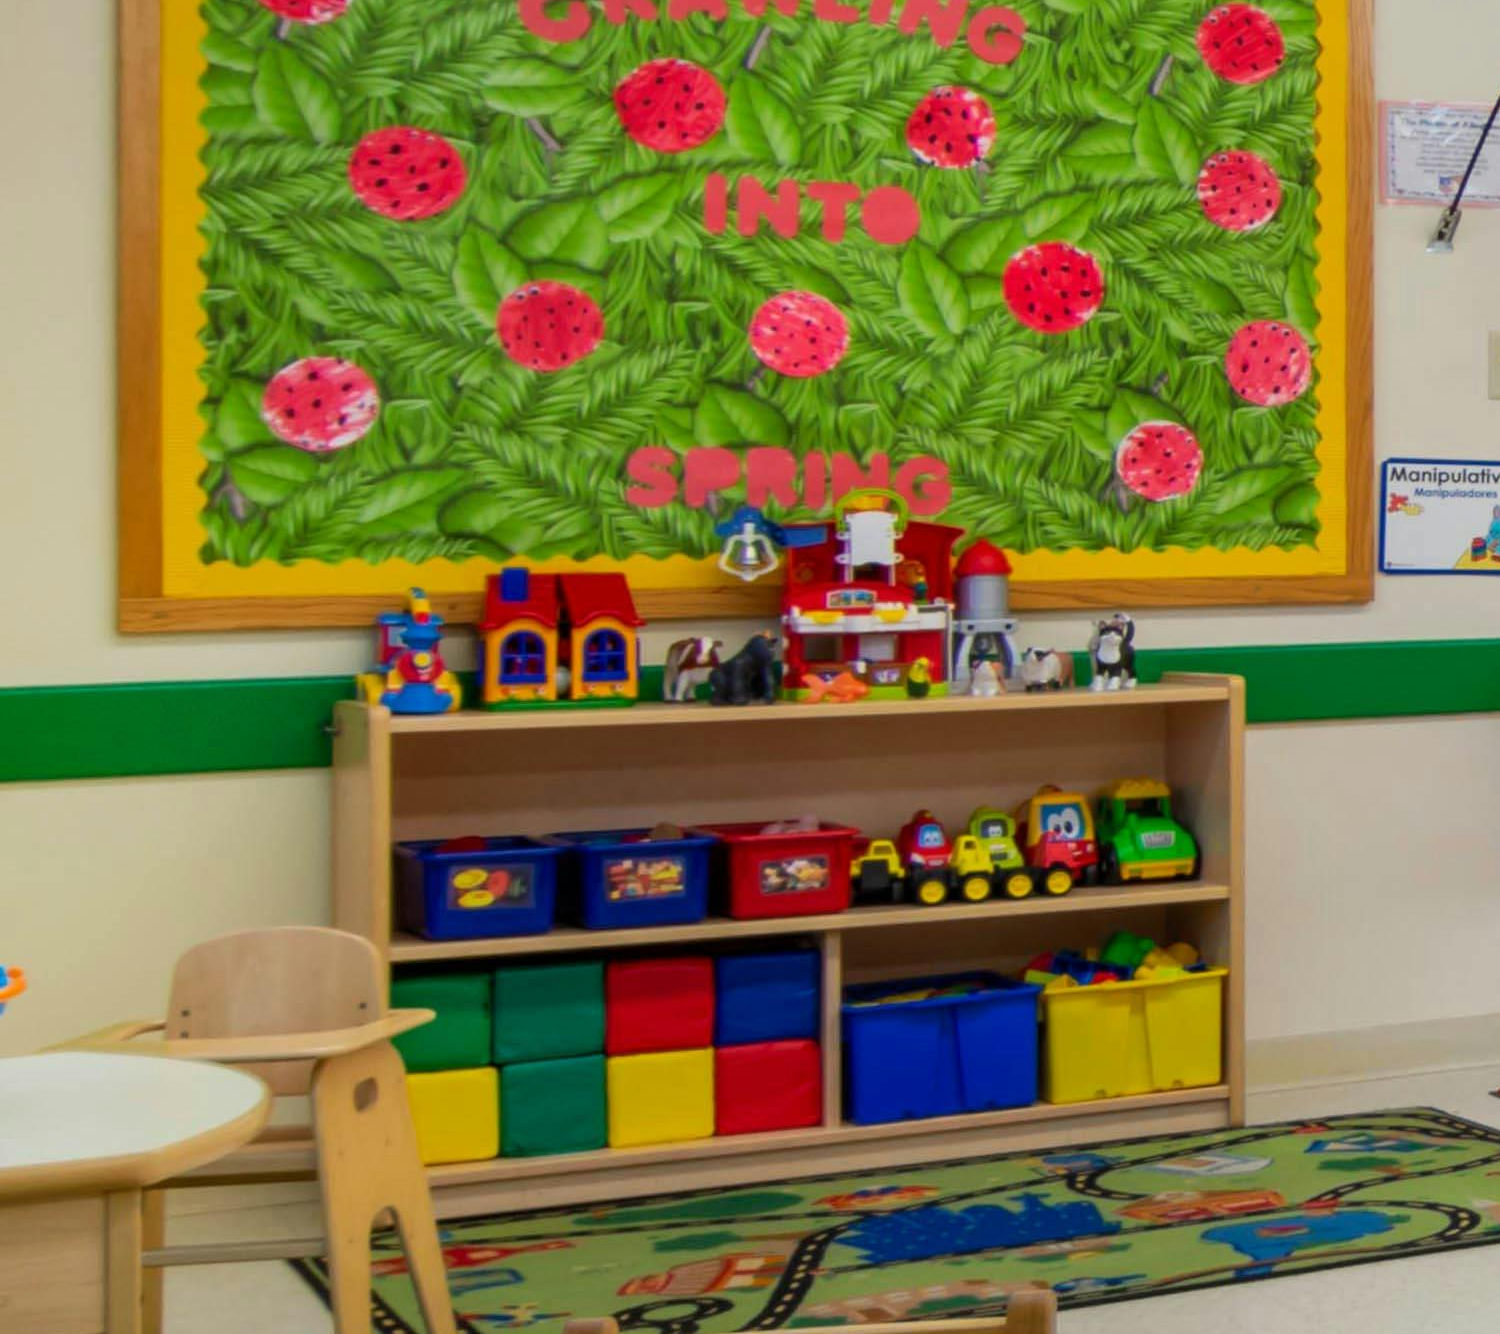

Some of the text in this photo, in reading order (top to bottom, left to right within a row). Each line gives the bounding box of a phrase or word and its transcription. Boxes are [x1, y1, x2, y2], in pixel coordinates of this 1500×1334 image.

[703, 171, 921, 245] INTO
[626, 445, 952, 516] SPRING
[1414, 487, 1498, 499] Manipuladores
